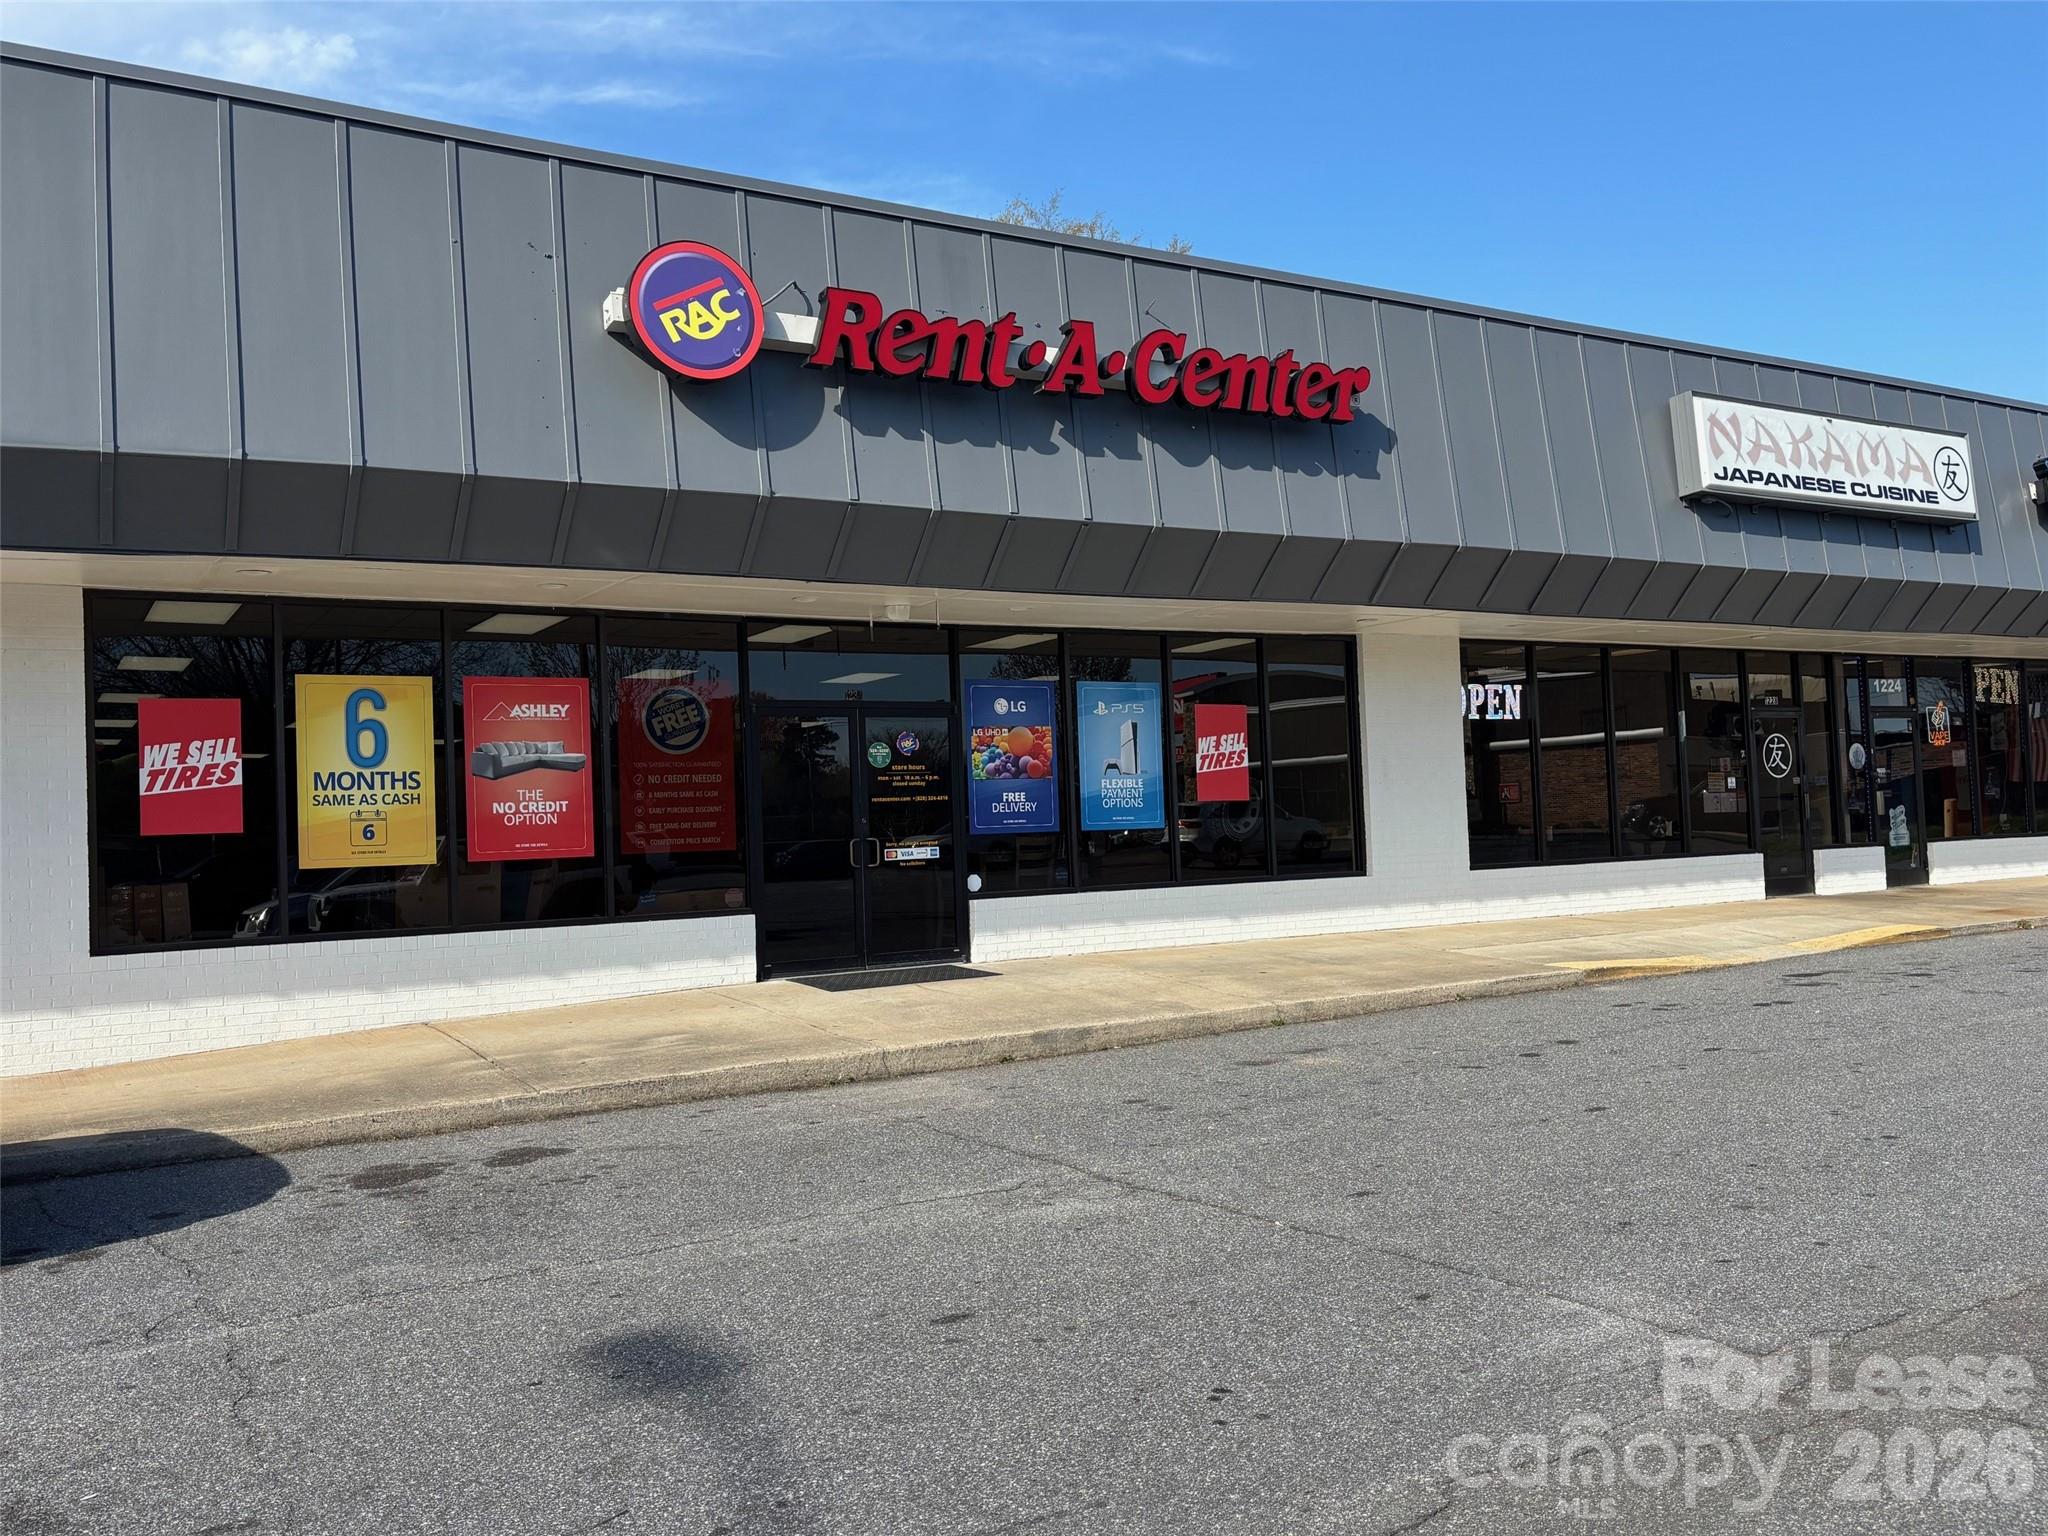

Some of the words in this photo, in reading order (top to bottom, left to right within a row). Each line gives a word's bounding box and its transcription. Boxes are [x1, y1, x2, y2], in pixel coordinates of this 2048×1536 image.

[658, 288, 741, 343] RAC
[1707, 408, 1935, 487] NAKAMA
[1941, 455, 1965, 494] 友
[1714, 466, 1847, 495] JAPANESE
[1850, 482, 1940, 504] CUISINE
[1873, 679, 1902, 693] 1224
[510, 704, 570, 718] ASHLEY
[1010, 700, 1027, 712] LG
[1111, 703, 1145, 714] PS5
[651, 704, 701, 737] FREE
[346, 687, 388, 769] 6
[972, 728, 983, 736] LG
[985, 728, 1001, 736] UHD
[1929, 730, 1949, 741] VAPE
[1198, 736, 1217, 754] WE
[1219, 732, 1246, 752] SELL
[144, 742, 182, 768] WE
[185, 737, 238, 764] SELL
[1767, 737, 1788, 770] 友
[1199, 749, 1247, 771] TIRES
[144, 760, 240, 793] TIRES
[313, 771, 421, 791] MONTHS
[648, 775, 661, 784] NO
[663, 774, 690, 783] CREDIT
[692, 774, 722, 783] NEEDED
[1101, 778, 1144, 788] FLEXIBLE
[312, 794, 355, 806] SAME
[358, 793, 377, 806] AS
[382, 793, 421, 805] CASH
[516, 789, 544, 801] THE
[1003, 792, 1026, 802] FREE
[1101, 788, 1144, 798] PAYMENT
[493, 802, 516, 814] NO
[519, 800, 569, 813] CREDIT
[992, 802, 1037, 813] DELIVERY
[1102, 798, 1144, 808] OPTIONS
[504, 812, 558, 826] OPTION
[362, 823, 376, 841] 6
